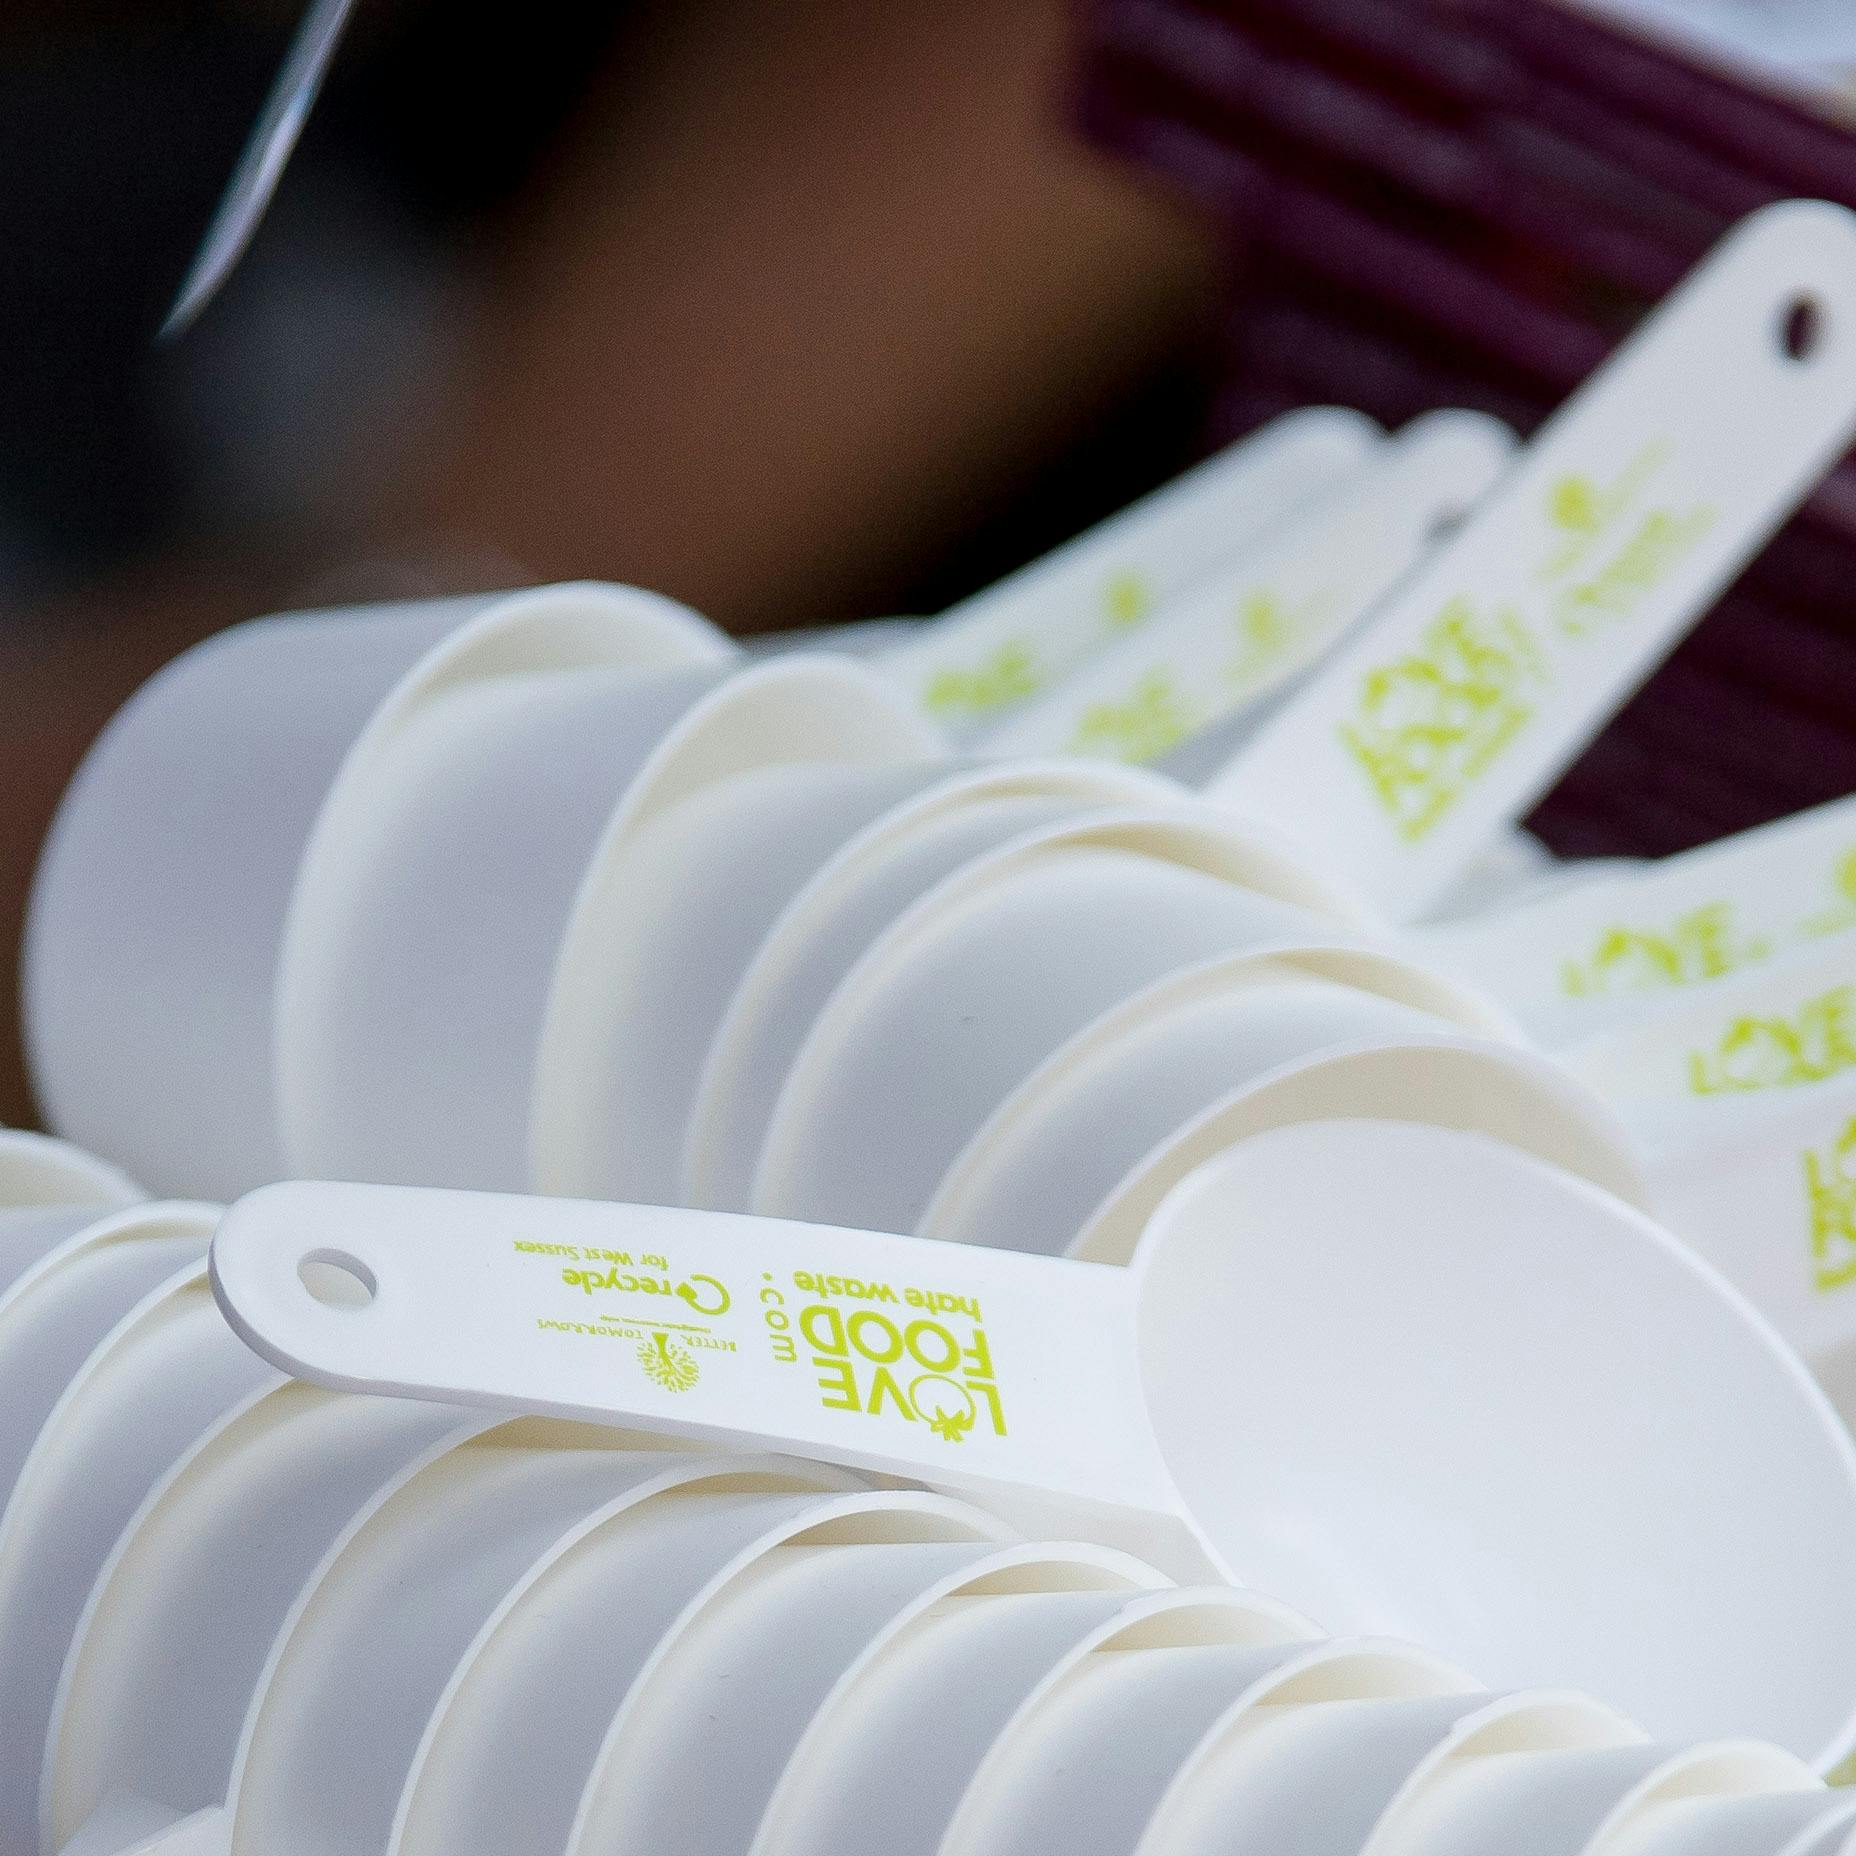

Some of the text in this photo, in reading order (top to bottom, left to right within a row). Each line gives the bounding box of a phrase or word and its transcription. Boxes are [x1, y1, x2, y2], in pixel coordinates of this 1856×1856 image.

[513, 1240, 669, 1271] for West Sussex
[562, 1267, 673, 1296] recycle
[793, 1270, 983, 1323] hate waste
[536, 1318, 645, 1339] TOMORROWS
[680, 1334, 737, 1352] BETTER
[799, 1304, 995, 1380] FOOD
[812, 1356, 1008, 1442] LOVE
